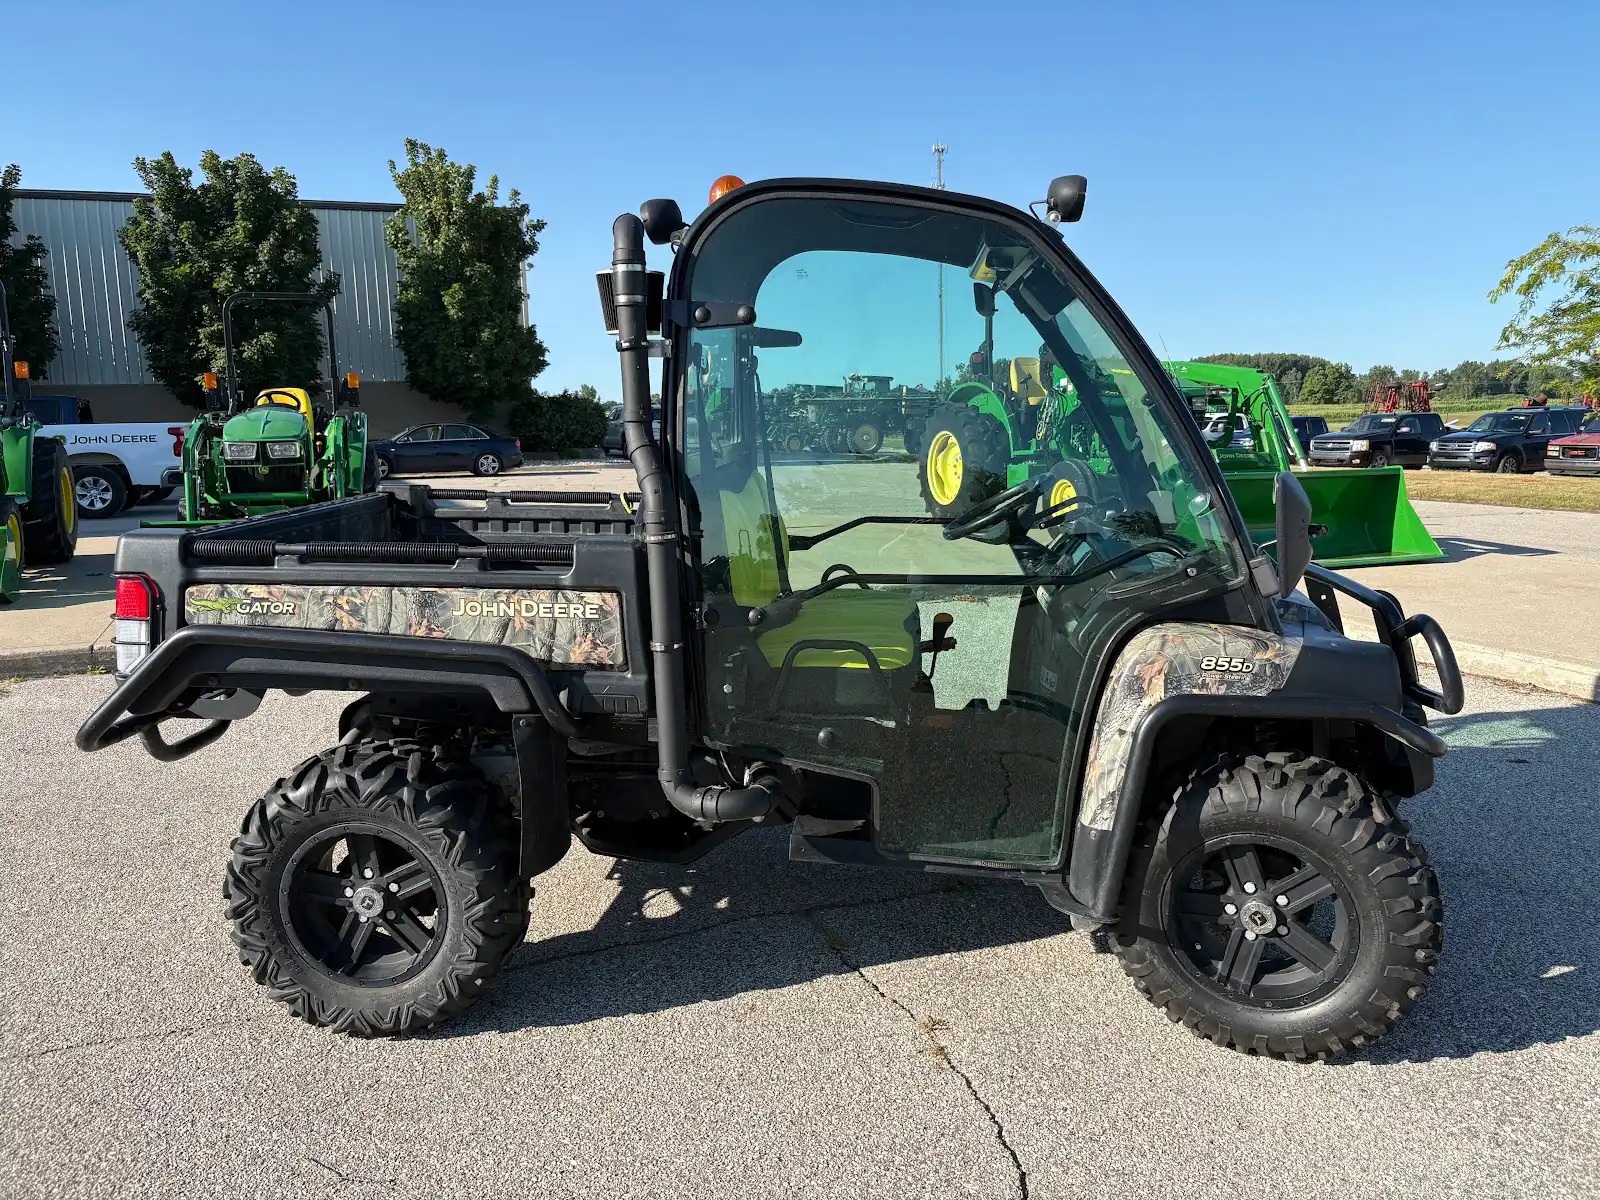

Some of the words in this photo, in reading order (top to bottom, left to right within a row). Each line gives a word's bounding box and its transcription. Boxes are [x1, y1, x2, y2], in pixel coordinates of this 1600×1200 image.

[70, 435, 108, 445] JOHN
[111, 434, 157, 443] DEERE
[236, 599, 296, 615] GATOR
[452, 598, 515, 617] JOHN
[520, 599, 600, 619] DEERE
[1200, 656, 1254, 673] 855D
